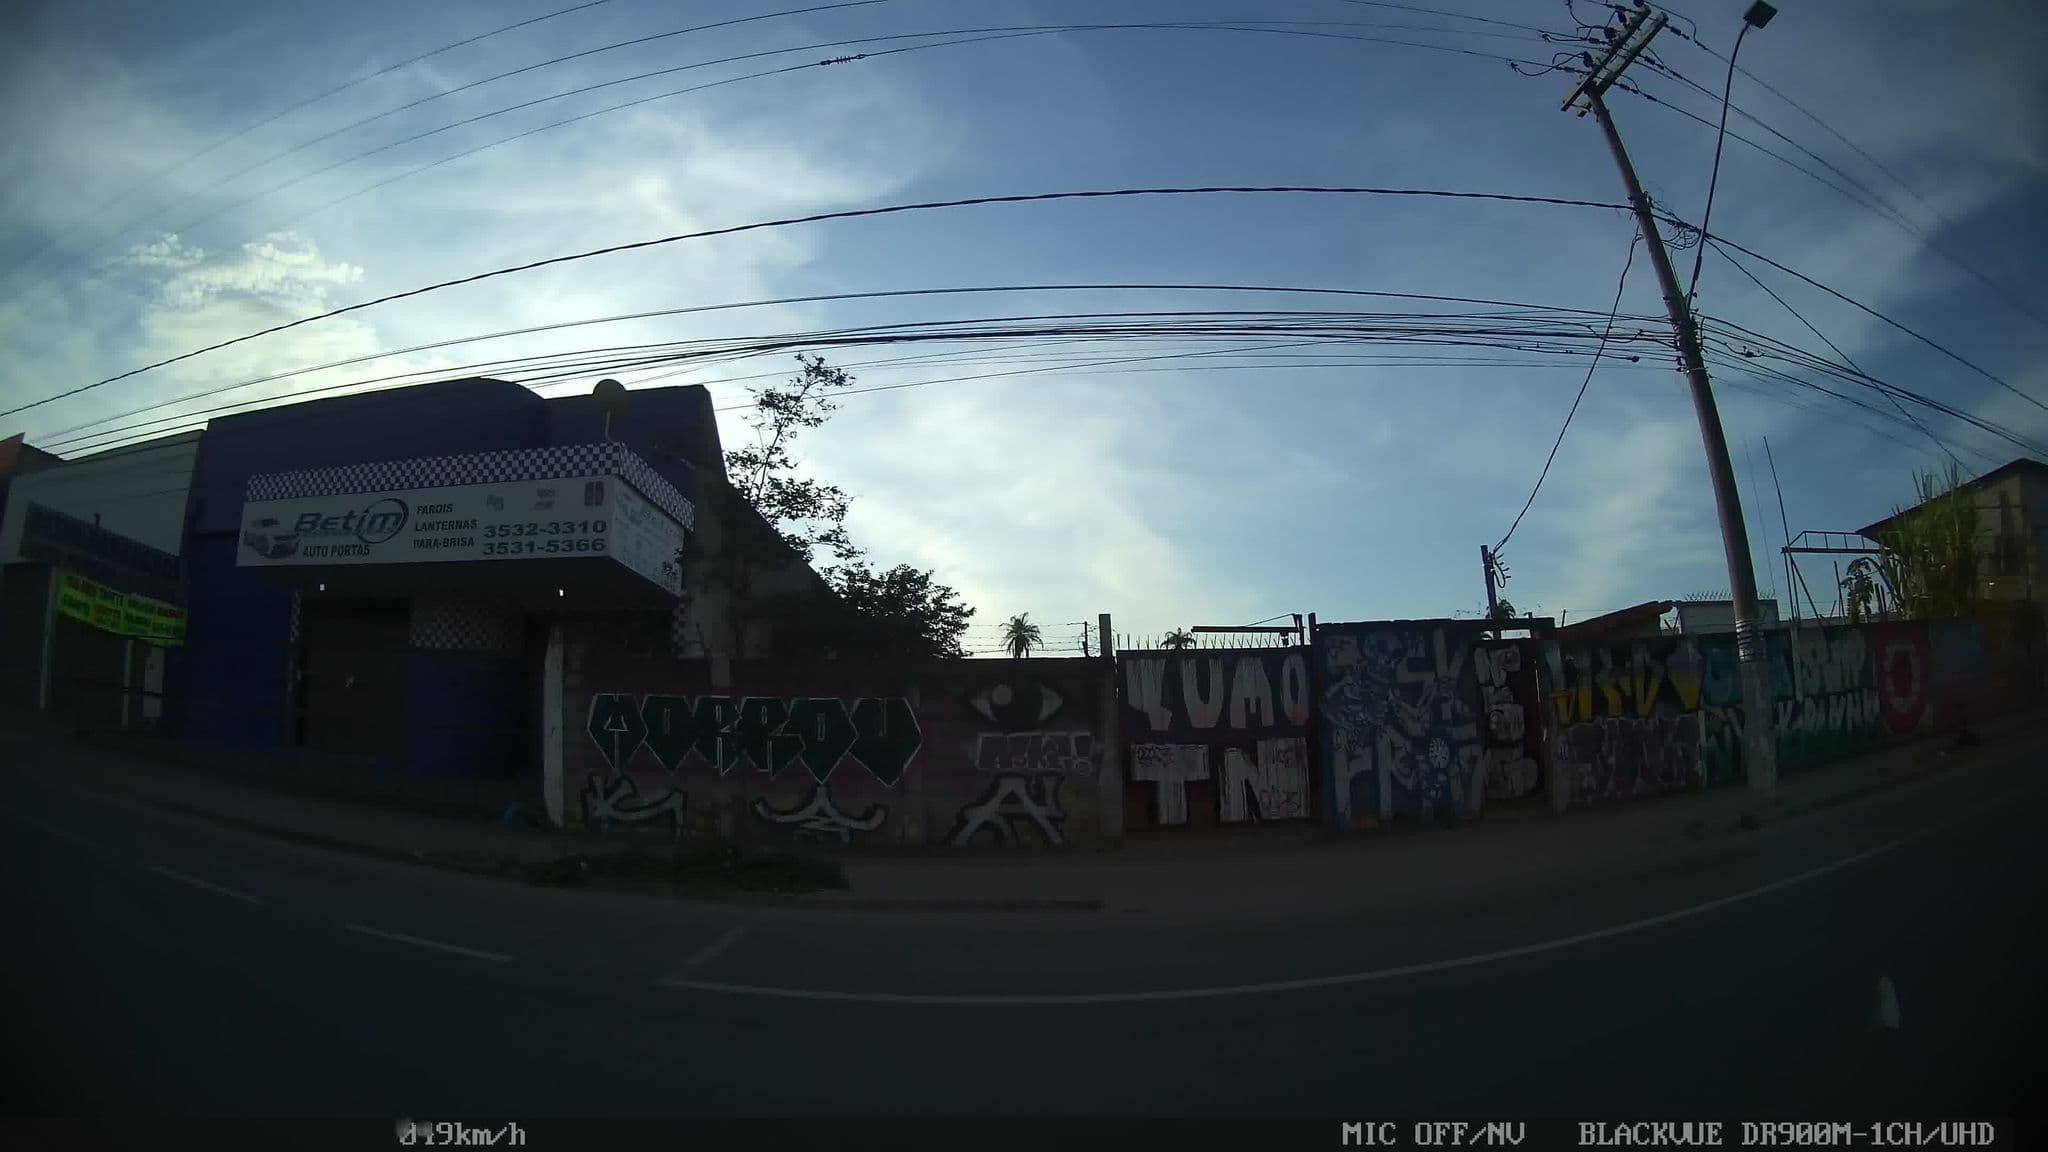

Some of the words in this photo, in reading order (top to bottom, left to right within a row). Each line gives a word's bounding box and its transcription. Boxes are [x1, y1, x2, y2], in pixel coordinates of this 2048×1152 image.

[415, 519, 478, 531] LANTERNAS
[483, 520, 607, 538] 3532-3310
[414, 537, 475, 549] PARA-BRISA
[483, 538, 607, 555] 3531-5366
[303, 545, 329, 558] AUTO
[330, 544, 371, 557] PORTAS
